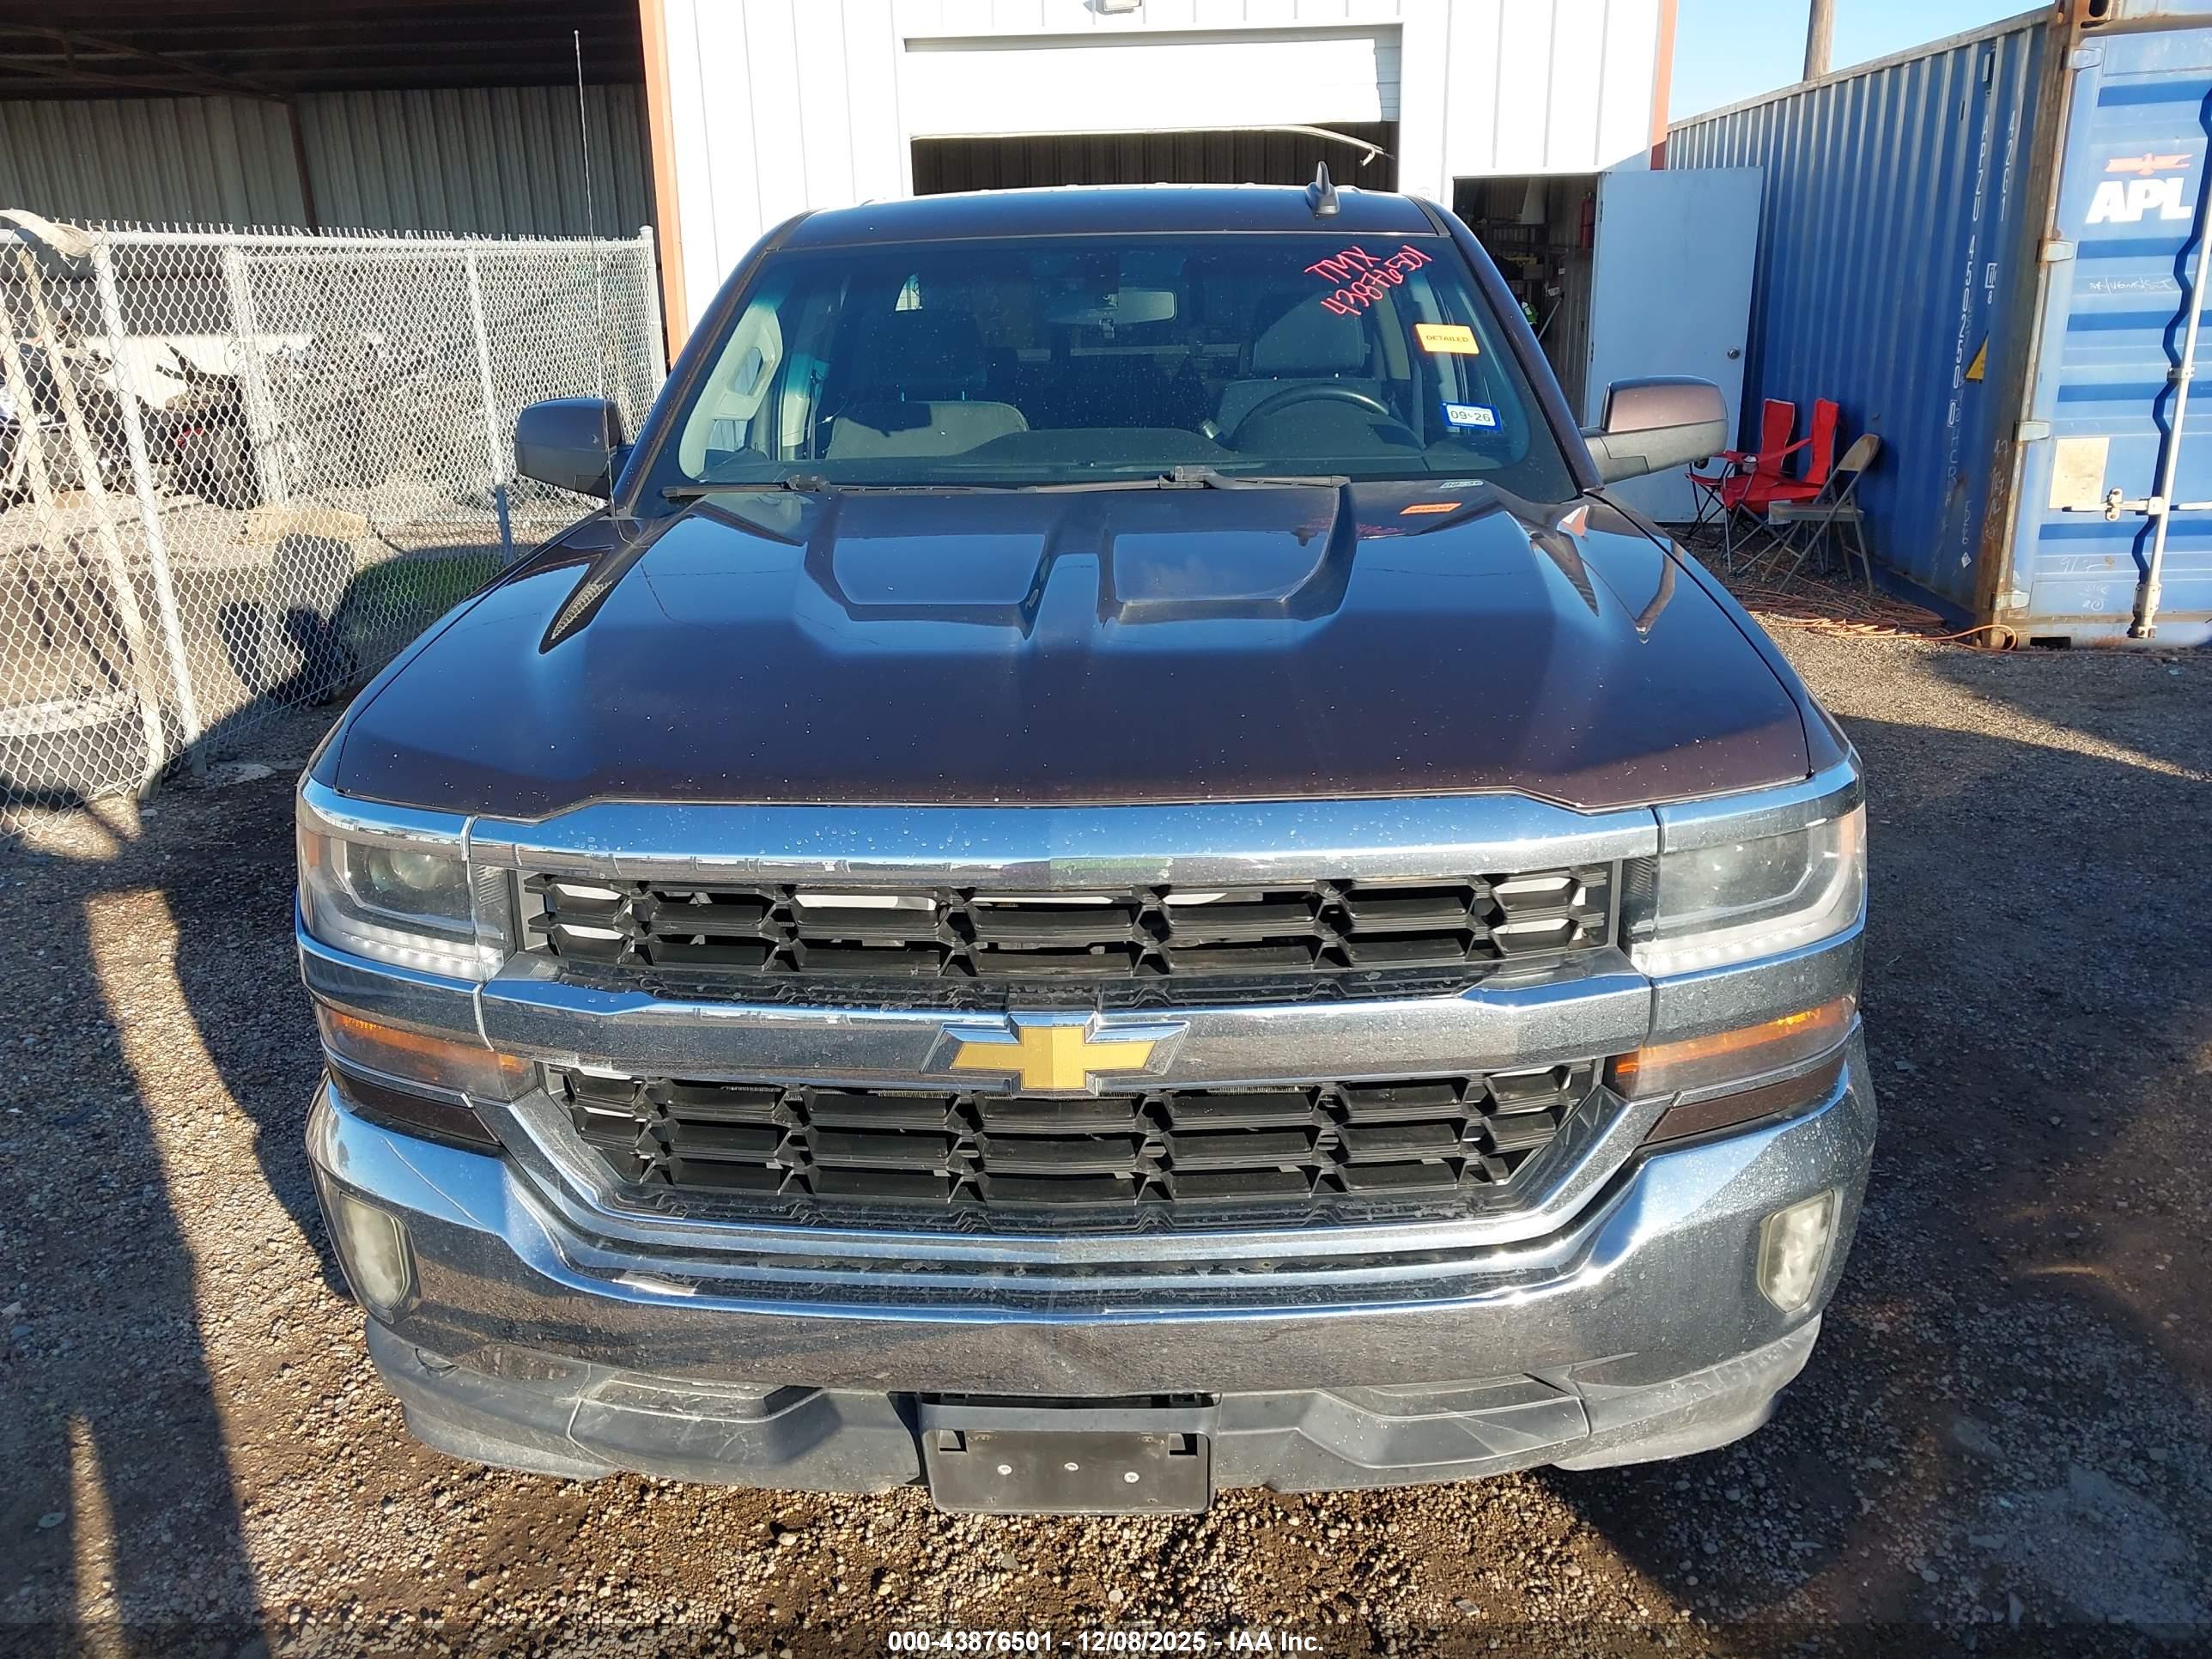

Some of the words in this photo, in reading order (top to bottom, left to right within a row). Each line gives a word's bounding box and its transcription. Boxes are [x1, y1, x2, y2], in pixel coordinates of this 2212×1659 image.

[2085, 177, 2193, 224] APL
[1304, 245, 1382, 284] TMX
[1425, 334, 1469, 343] DETAILED
